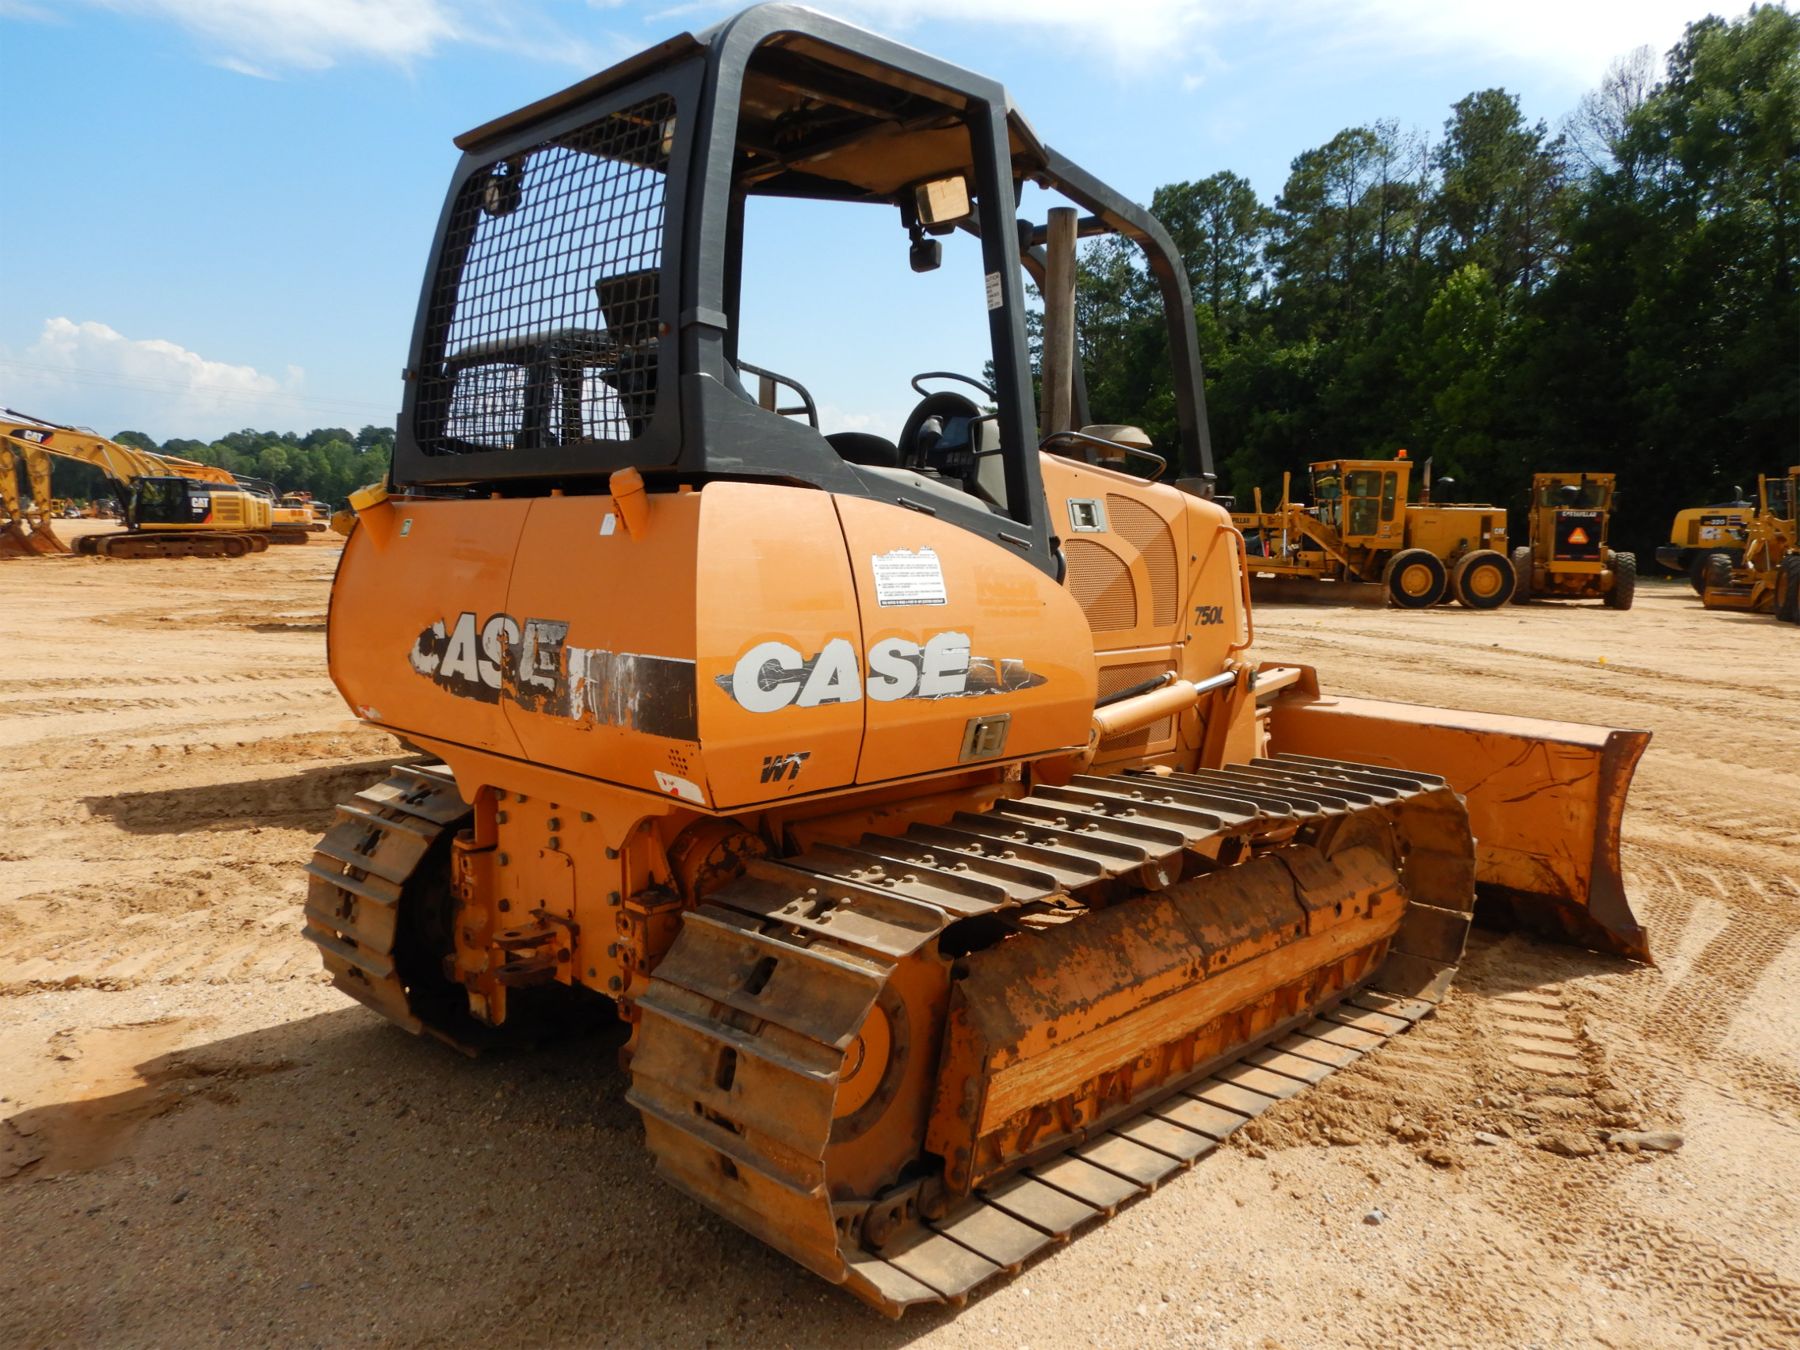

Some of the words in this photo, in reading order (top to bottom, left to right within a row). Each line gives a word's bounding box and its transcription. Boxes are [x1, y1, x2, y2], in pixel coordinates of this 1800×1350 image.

[24, 430, 44, 443] CAT
[191, 497, 209, 508] CAT
[1194, 605, 1224, 626] 750L
[408, 611, 571, 693] CASE
[731, 631, 972, 713] CASE
[760, 751, 811, 784] WT
